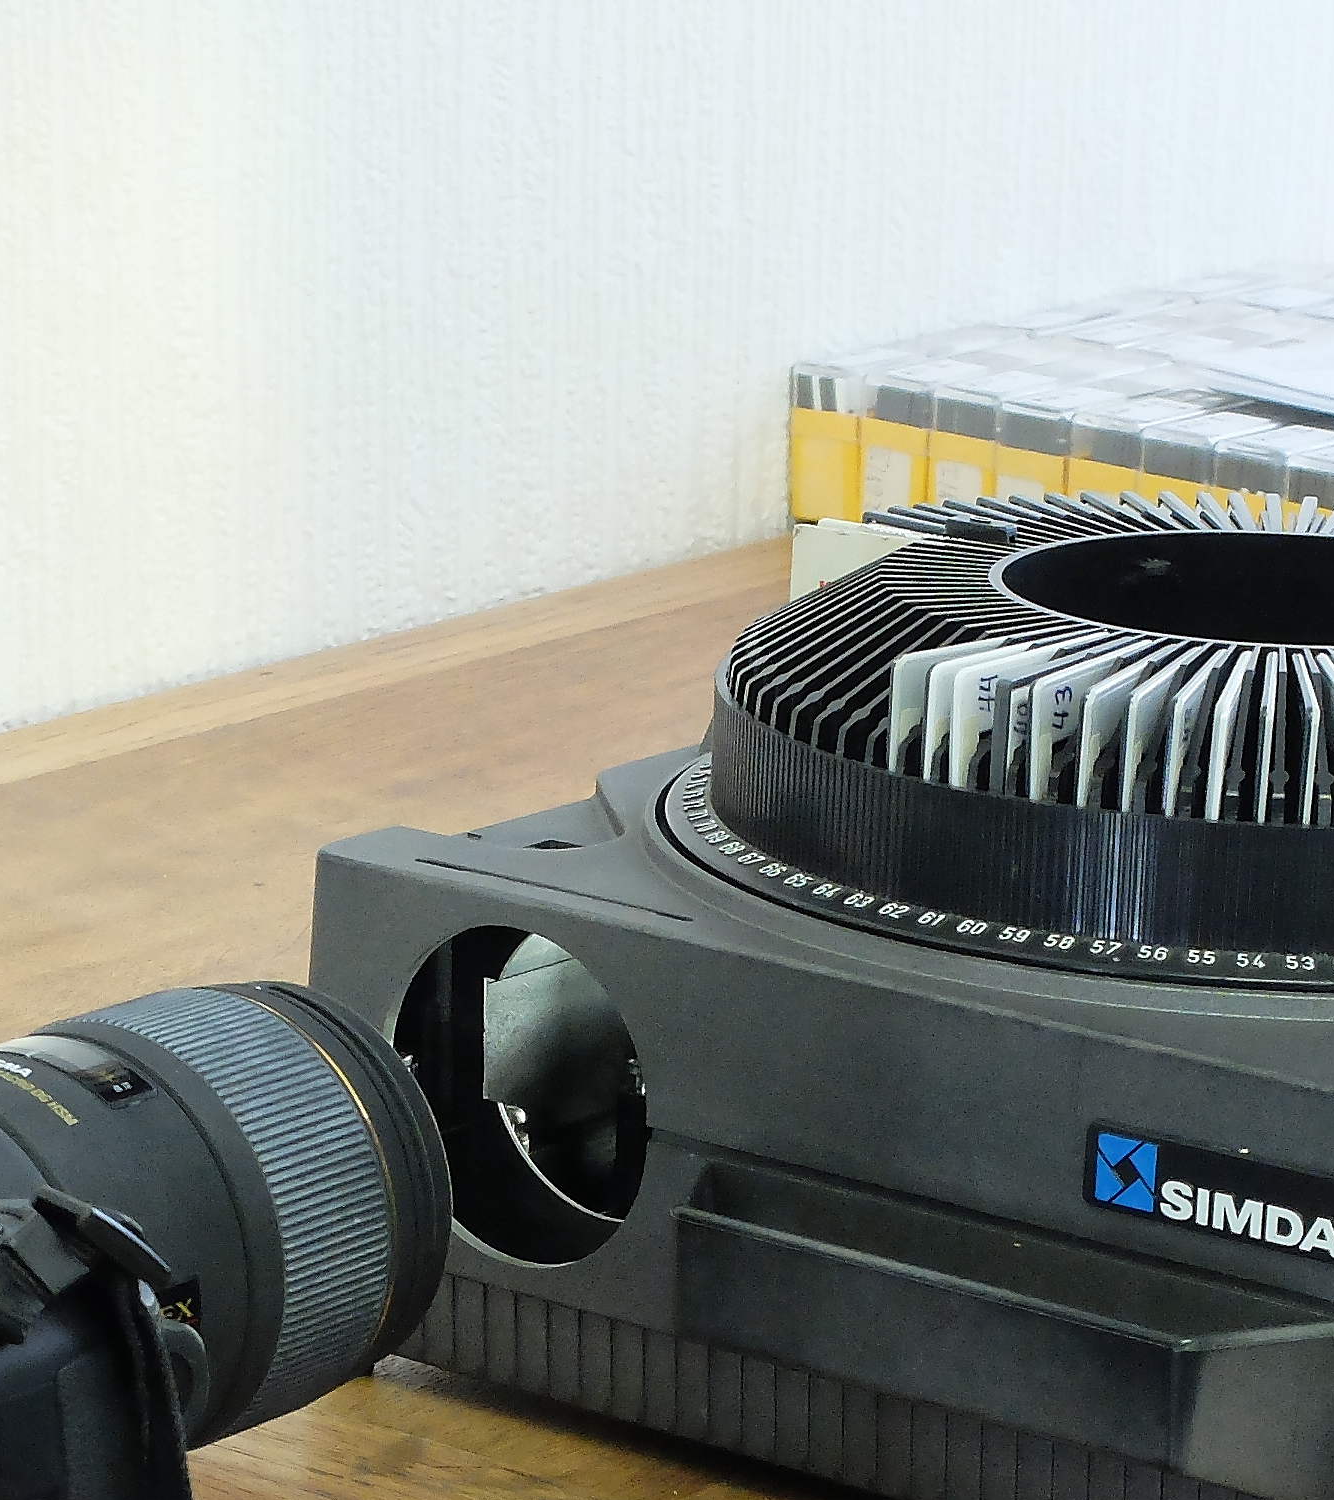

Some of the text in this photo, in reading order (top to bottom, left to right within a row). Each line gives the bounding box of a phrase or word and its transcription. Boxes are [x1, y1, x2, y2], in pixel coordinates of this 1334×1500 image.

[1052, 685, 1073, 731] 43
[718, 841, 746, 855] 68
[737, 852, 766, 865] 67
[758, 863, 788, 877] 66
[783, 873, 815, 888] 65
[812, 883, 842, 898] 64
[843, 893, 875, 908] 63
[878, 902, 910, 919] 62
[917, 911, 947, 927] 61
[955, 919, 989, 935] 60
[998, 926, 1031, 943] 59
[1043, 934, 1076, 950] 58
[1089, 940, 1123, 956] 57
[1137, 945, 1169, 961] 56
[1187, 949, 1216, 965] 55
[1236, 952, 1266, 969] 54
[1285, 955, 1316, 971] 53
